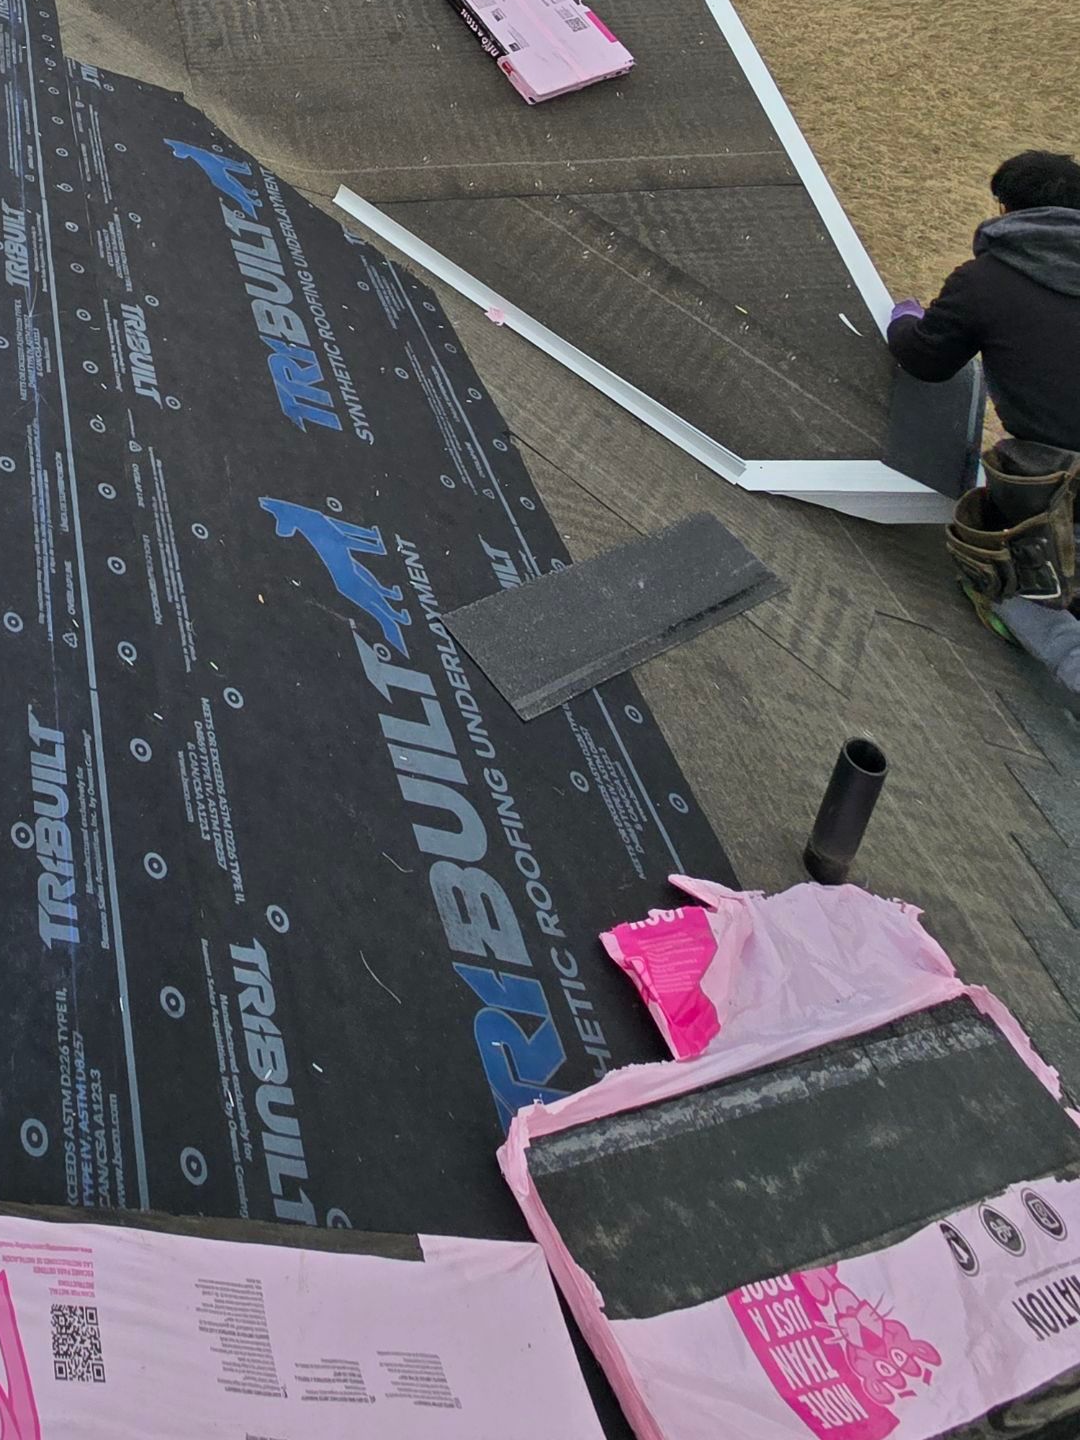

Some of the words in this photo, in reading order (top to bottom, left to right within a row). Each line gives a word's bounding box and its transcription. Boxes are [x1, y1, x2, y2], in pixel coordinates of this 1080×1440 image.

[261, 167, 309, 268] UNDERLAYMENT
[0, 198, 31, 289] TRIBUILT
[220, 197, 344, 433] TRIBUILT
[297, 269, 336, 342] ROOFING
[120, 303, 163, 409] TRIBUILT
[323, 343, 375, 446] SYNTHETIC
[395, 534, 497, 761] UNDERLAYMENT
[193, 720, 208, 754] D4869
[200, 697, 215, 730] MEETS
[206, 730, 217, 747] OR
[188, 751, 205, 800] CAN/CSA
[199, 754, 212, 782] TYPE
[209, 747, 226, 795] EXCEEDS
[28, 718, 81, 950] TRIBUILT
[196, 800, 211, 841] A123.3
[207, 797, 221, 832] ASTM
[217, 794, 232, 829] ASTM
[212, 831, 228, 871] D8257
[223, 828, 238, 860] D226
[483, 766, 568, 938] ROOFING
[229, 860, 244, 892] TYPE
[354, 628, 572, 1137] RIBUILT
[55, 1002, 69, 1043] TYPE
[551, 946, 612, 1079] HETIC
[58, 1044, 72, 1087] D226
[72, 1030, 87, 1083] D8257
[220, 993, 239, 1075] Manufactured
[231, 1074, 250, 1141] exclusively
[243, 1141, 253, 1162] for
[230, 938, 317, 1226] TRIBUILT
[61, 1084, 76, 1140] ASTM
[75, 1083, 90, 1134] ASTM
[89, 1068, 105, 1128] A123.3
[228, 1119, 241, 1163] Owens
[63, 1140, 79, 1206] CEEDS
[80, 1161, 95, 1207] TYPE
[747, 1309, 770, 1342] A
[772, 1293, 814, 1338] JUST
[1011, 1273, 1080, 1344] ATION
[767, 1338, 840, 1389] THAN
[798, 1385, 870, 1430] MORE
